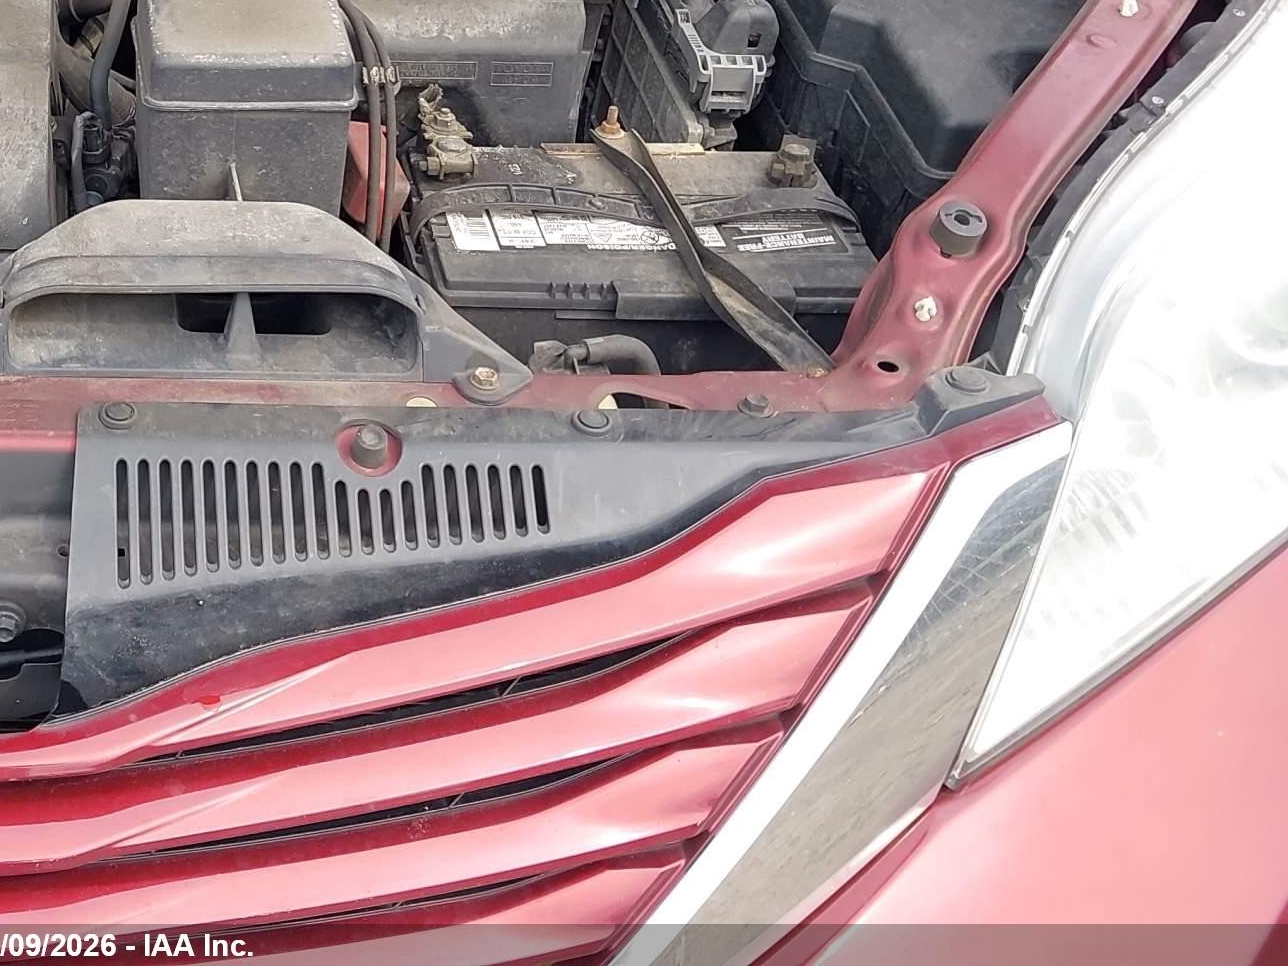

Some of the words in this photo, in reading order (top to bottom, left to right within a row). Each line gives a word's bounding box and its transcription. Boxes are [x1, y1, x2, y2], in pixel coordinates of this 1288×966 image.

[737, 235, 835, 252] MAINTENANCE-FREE
[762, 233, 806, 244] BATTERY
[586, 242, 677, 251] DANGER/POISON
